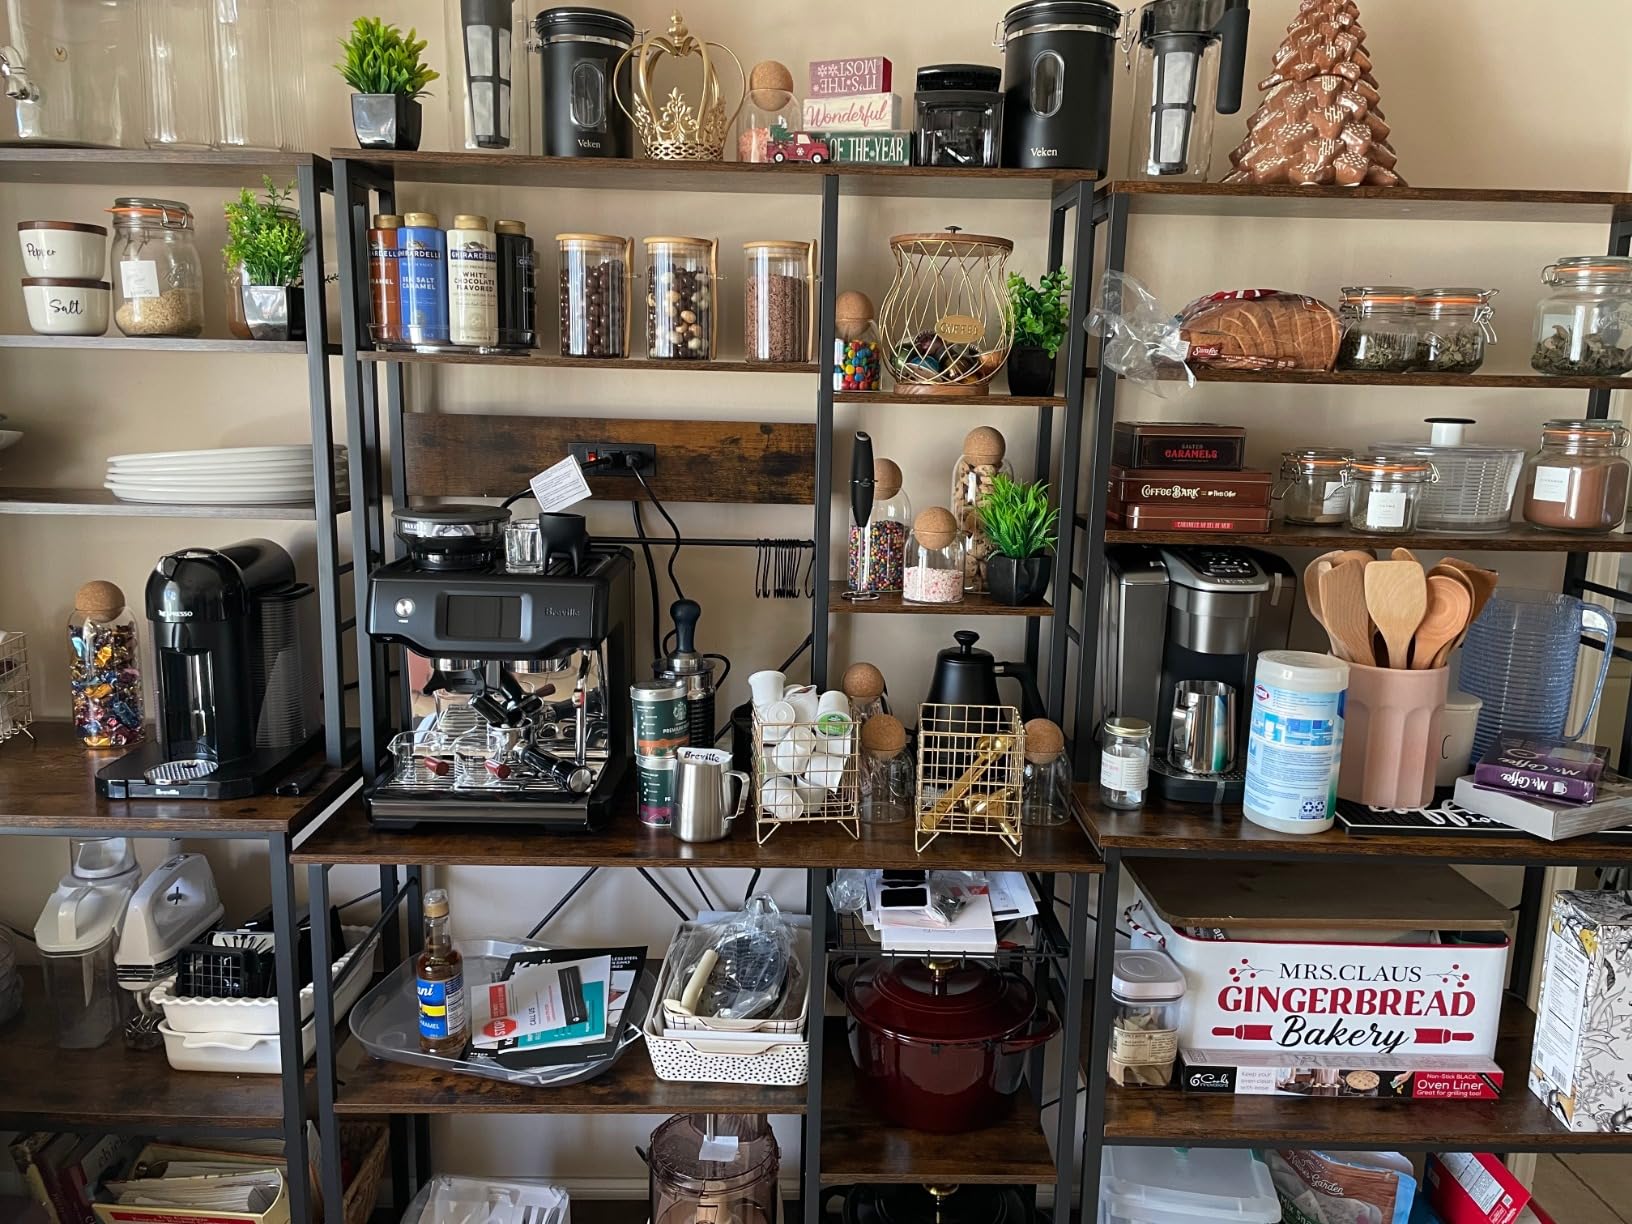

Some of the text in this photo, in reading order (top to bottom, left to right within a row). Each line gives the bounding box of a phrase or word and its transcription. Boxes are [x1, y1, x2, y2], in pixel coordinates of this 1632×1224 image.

[838, 59, 877, 76] MOST
[820, 75, 876, 94] IT'S THE
[806, 100, 888, 128] Wonderful
[578, 138, 600, 148] Veken
[830, 137, 904, 162] OF THE YEAR
[1030, 146, 1058, 157] Veken
[26, 242, 56, 260] Peper
[454, 278, 494, 286] CHOCOLATE
[456, 284, 494, 292] FLAVORED
[50, 298, 83, 316] Salt
[1164, 450, 1218, 459] CARAMELS
[544, 606, 580, 616] Breville
[684, 751, 720, 763] Breville
[1497, 757, 1548, 772] Coffee
[1500, 771, 1548, 791] Mr. Coffee
[1217, 985, 1476, 1017] GINGERBREAD
[494, 1018, 508, 1037] STOP
[1276, 1014, 1410, 1054] Bakery
[1417, 1080, 1450, 1090] Oven
[1453, 1080, 1484, 1090] Liner
[1446, 1090, 1468, 1098] grilling
[1311, 1174, 1344, 1194] Garden
